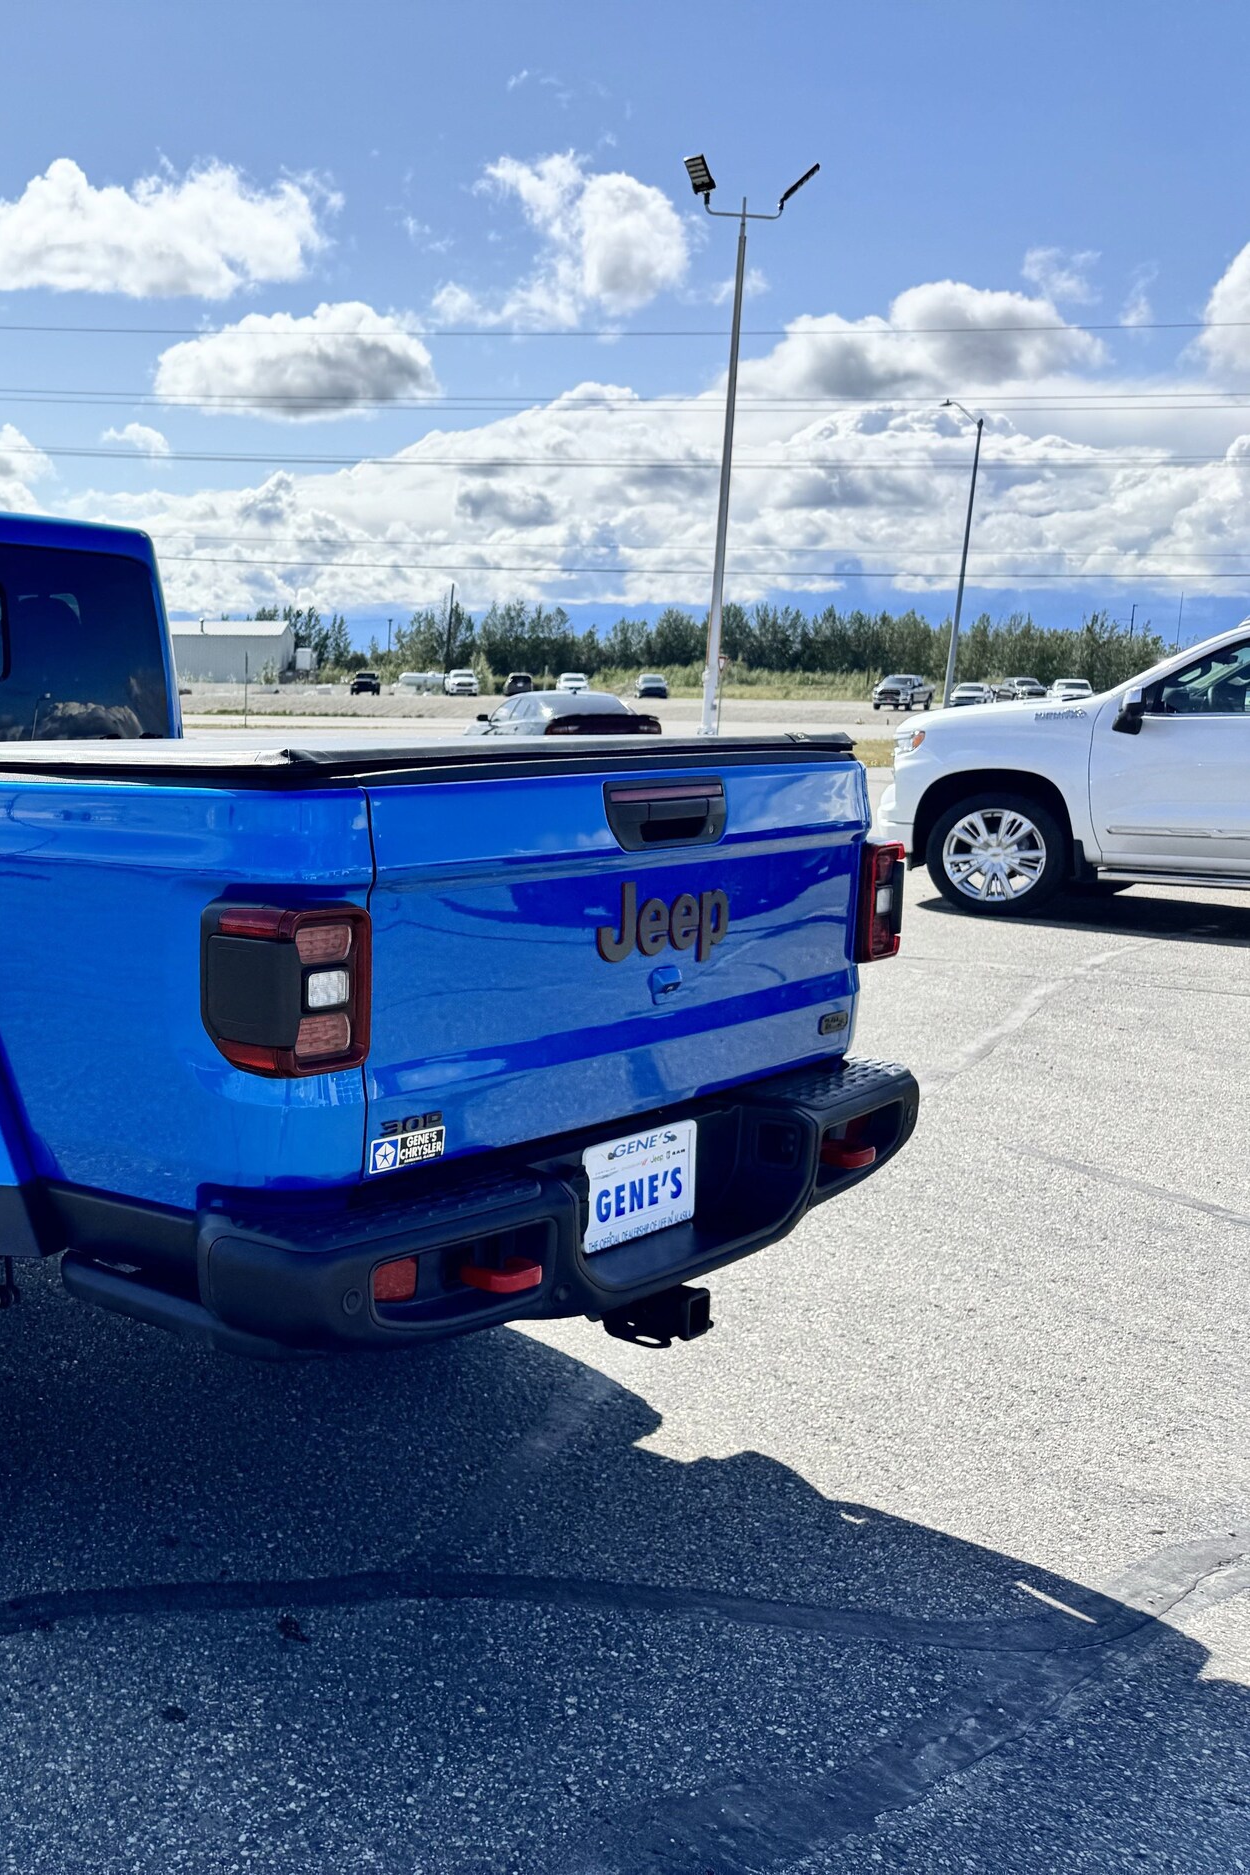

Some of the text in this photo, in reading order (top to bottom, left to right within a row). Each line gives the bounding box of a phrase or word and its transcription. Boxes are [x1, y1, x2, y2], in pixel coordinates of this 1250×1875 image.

[597, 881, 729, 962] Jeep
[400, 1141, 442, 1160] CHRYSLER
[406, 1131, 438, 1148] GENE'S
[613, 1131, 672, 1158] GENE'S
[595, 1166, 683, 1223] GENE'S
